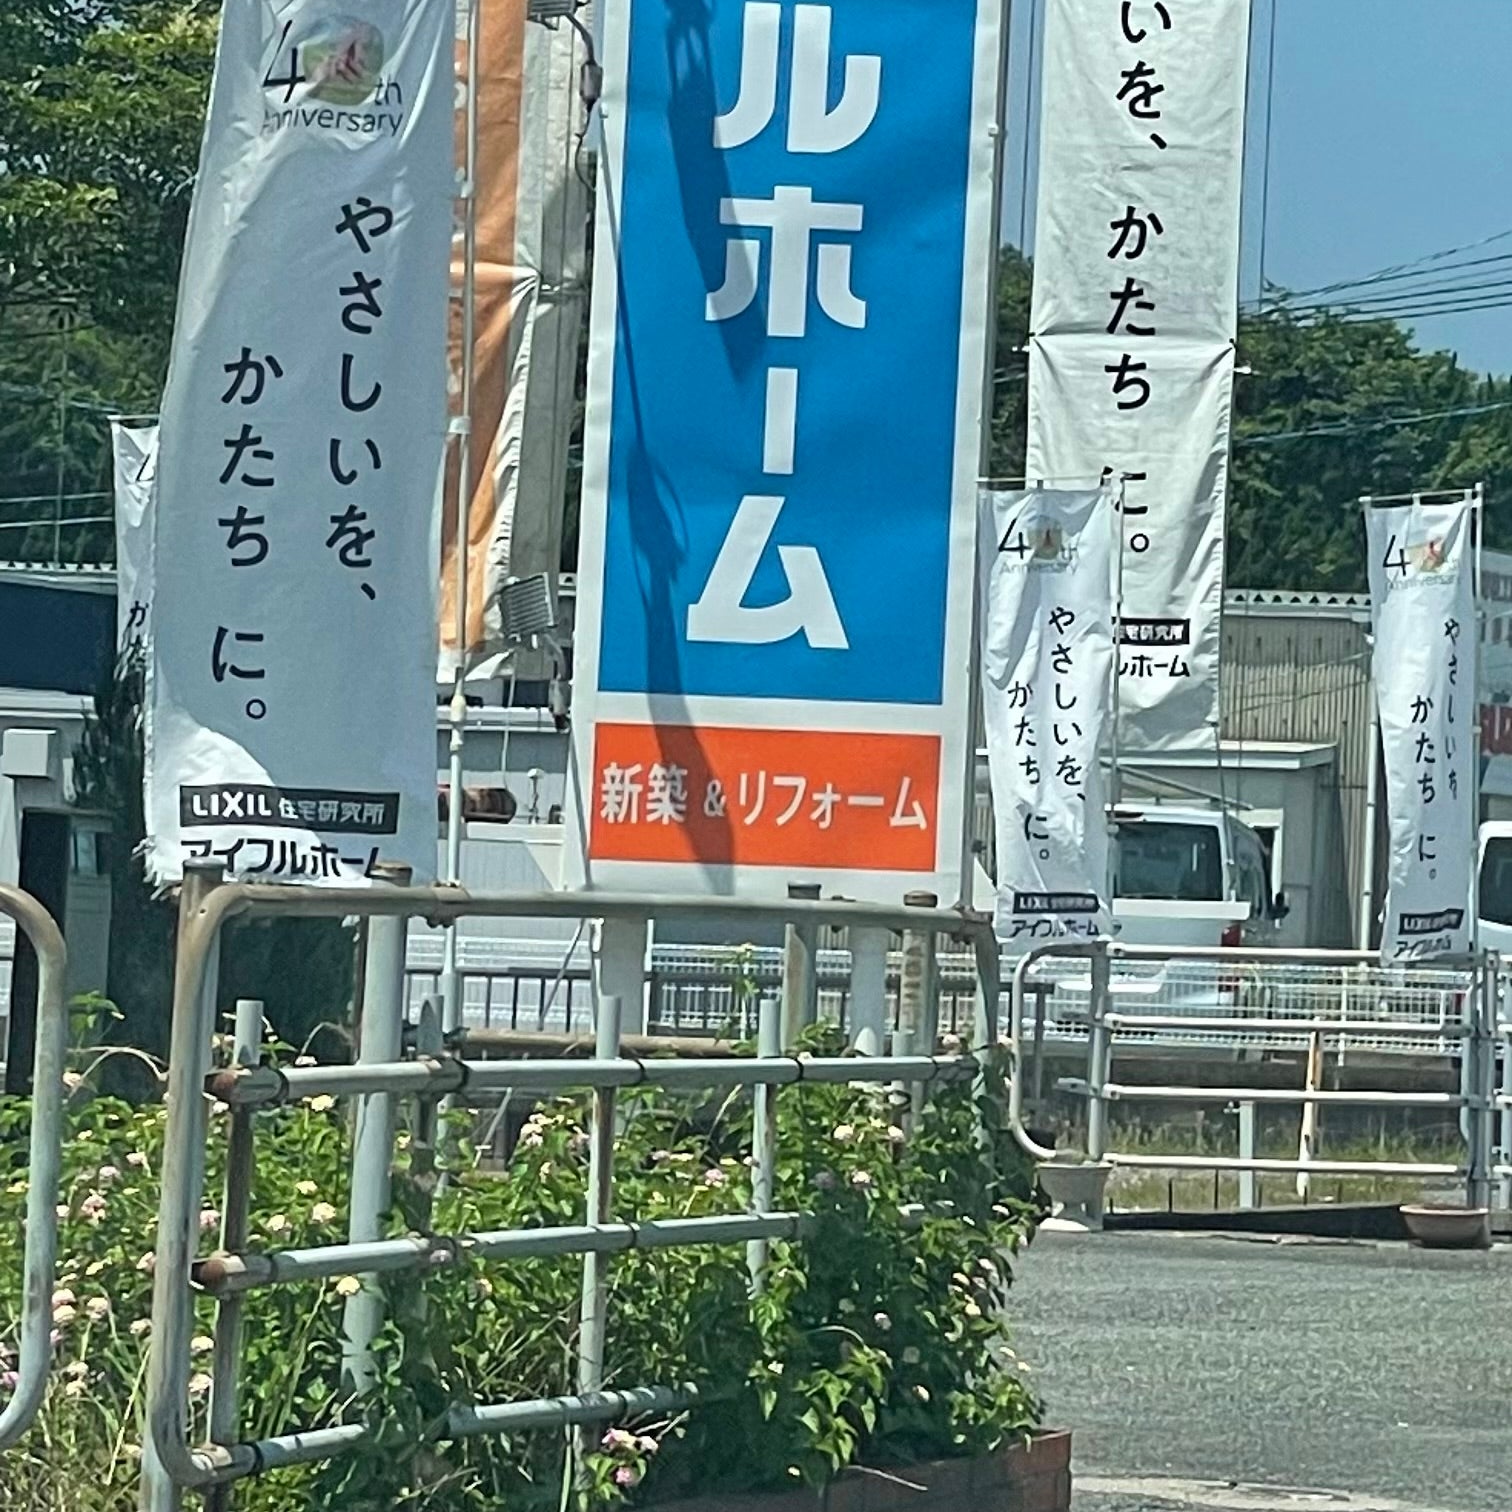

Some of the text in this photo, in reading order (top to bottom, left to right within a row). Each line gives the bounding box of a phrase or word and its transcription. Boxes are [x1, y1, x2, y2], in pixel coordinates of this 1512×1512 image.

[326, 195, 394, 602] やさしいを、
[1049, 606, 1086, 800] やさしいを、
[193, 791, 385, 825] LIXIL 住宅研究所
[600, 762, 928, 830] 新築 & リフォーム
